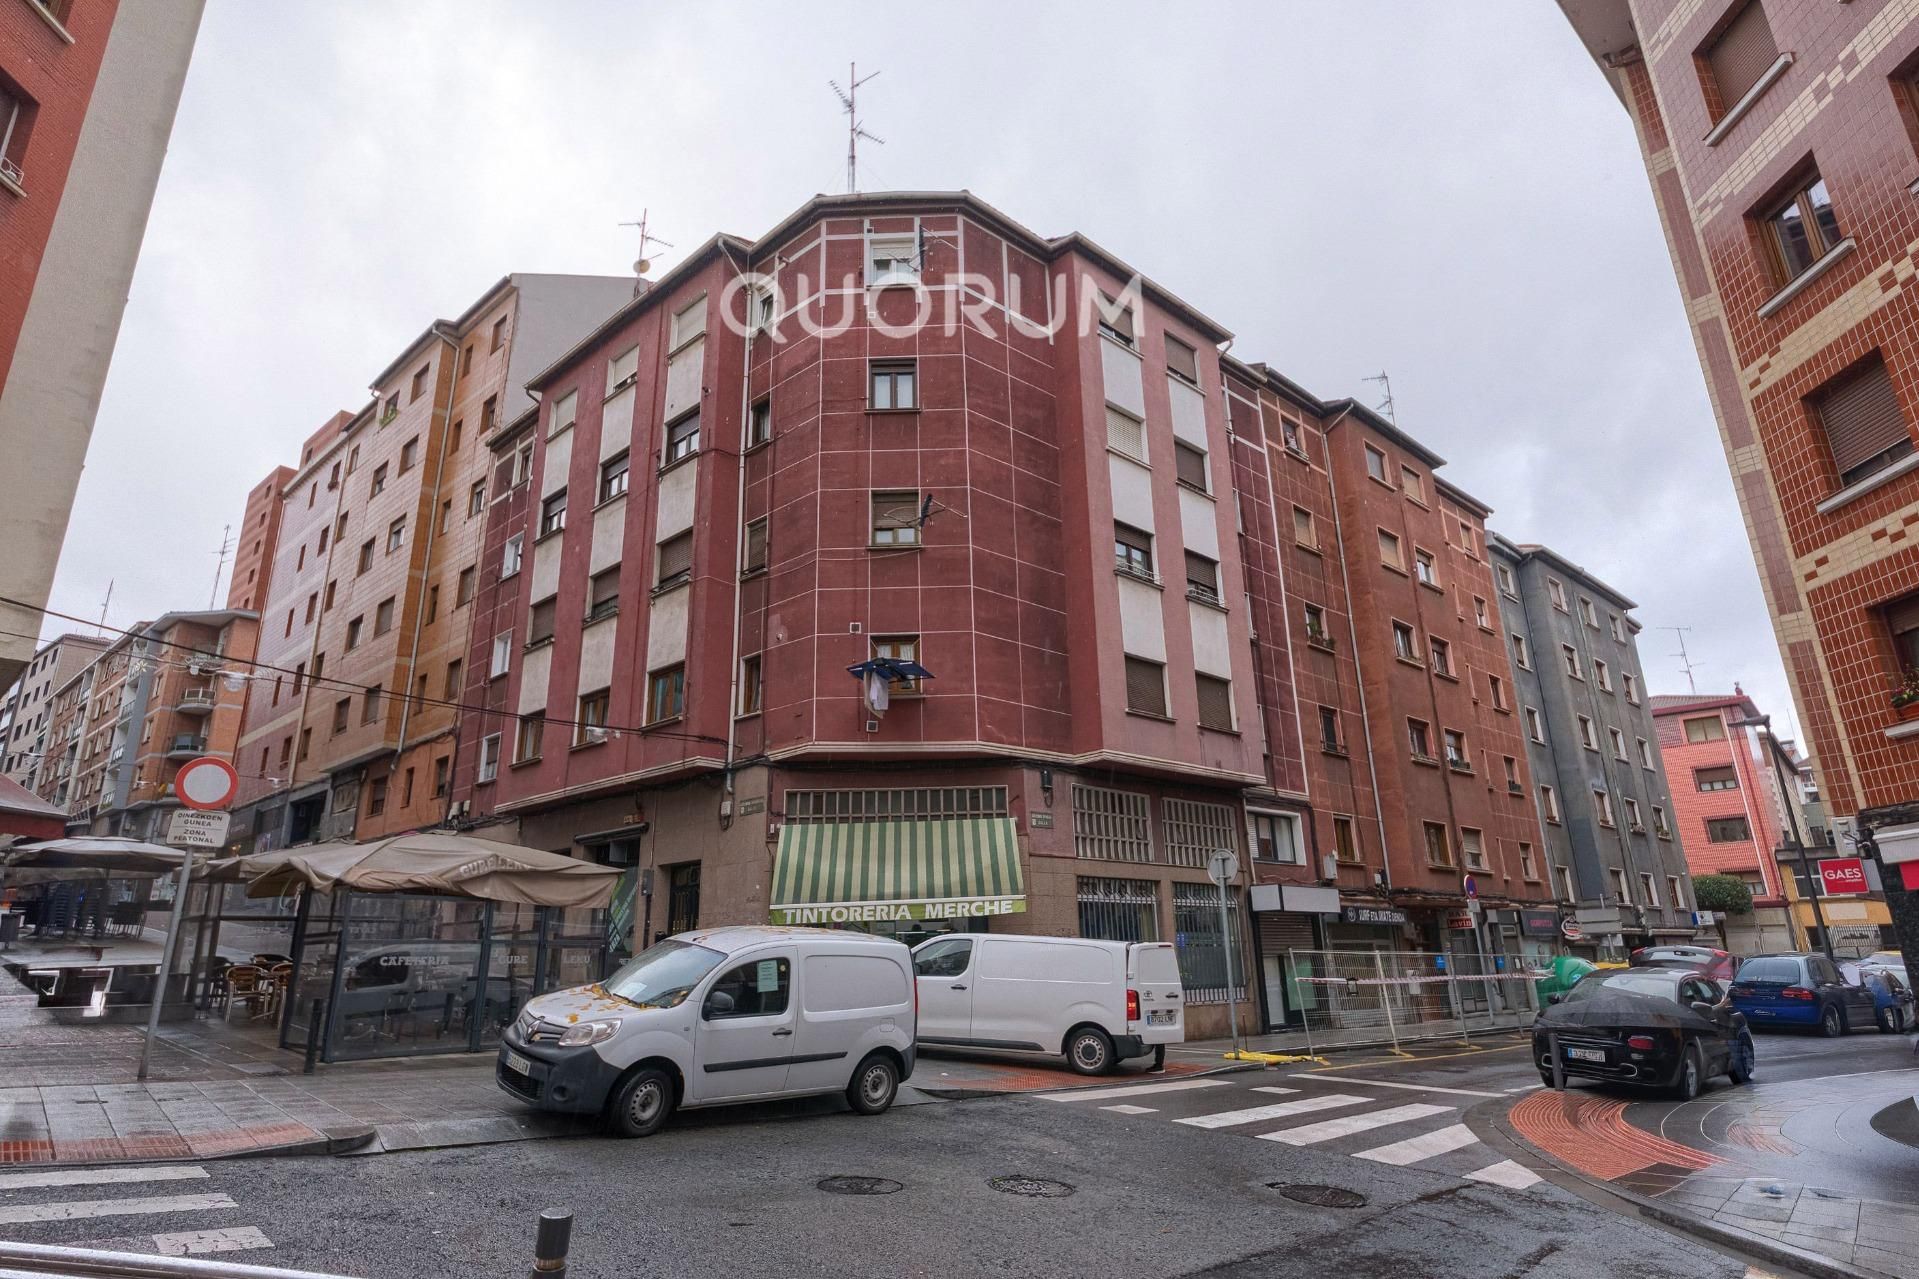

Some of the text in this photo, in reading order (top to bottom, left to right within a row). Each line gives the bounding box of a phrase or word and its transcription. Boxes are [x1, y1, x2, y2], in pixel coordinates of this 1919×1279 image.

[184, 819, 212, 827] GUNEA
[184, 828, 206, 837] ZONA
[1824, 868, 1863, 880] GAES
[783, 900, 1013, 925] TINTORERIA MERCHE
[380, 956, 449, 966] CAFETERIA
[498, 955, 528, 965] GURE
